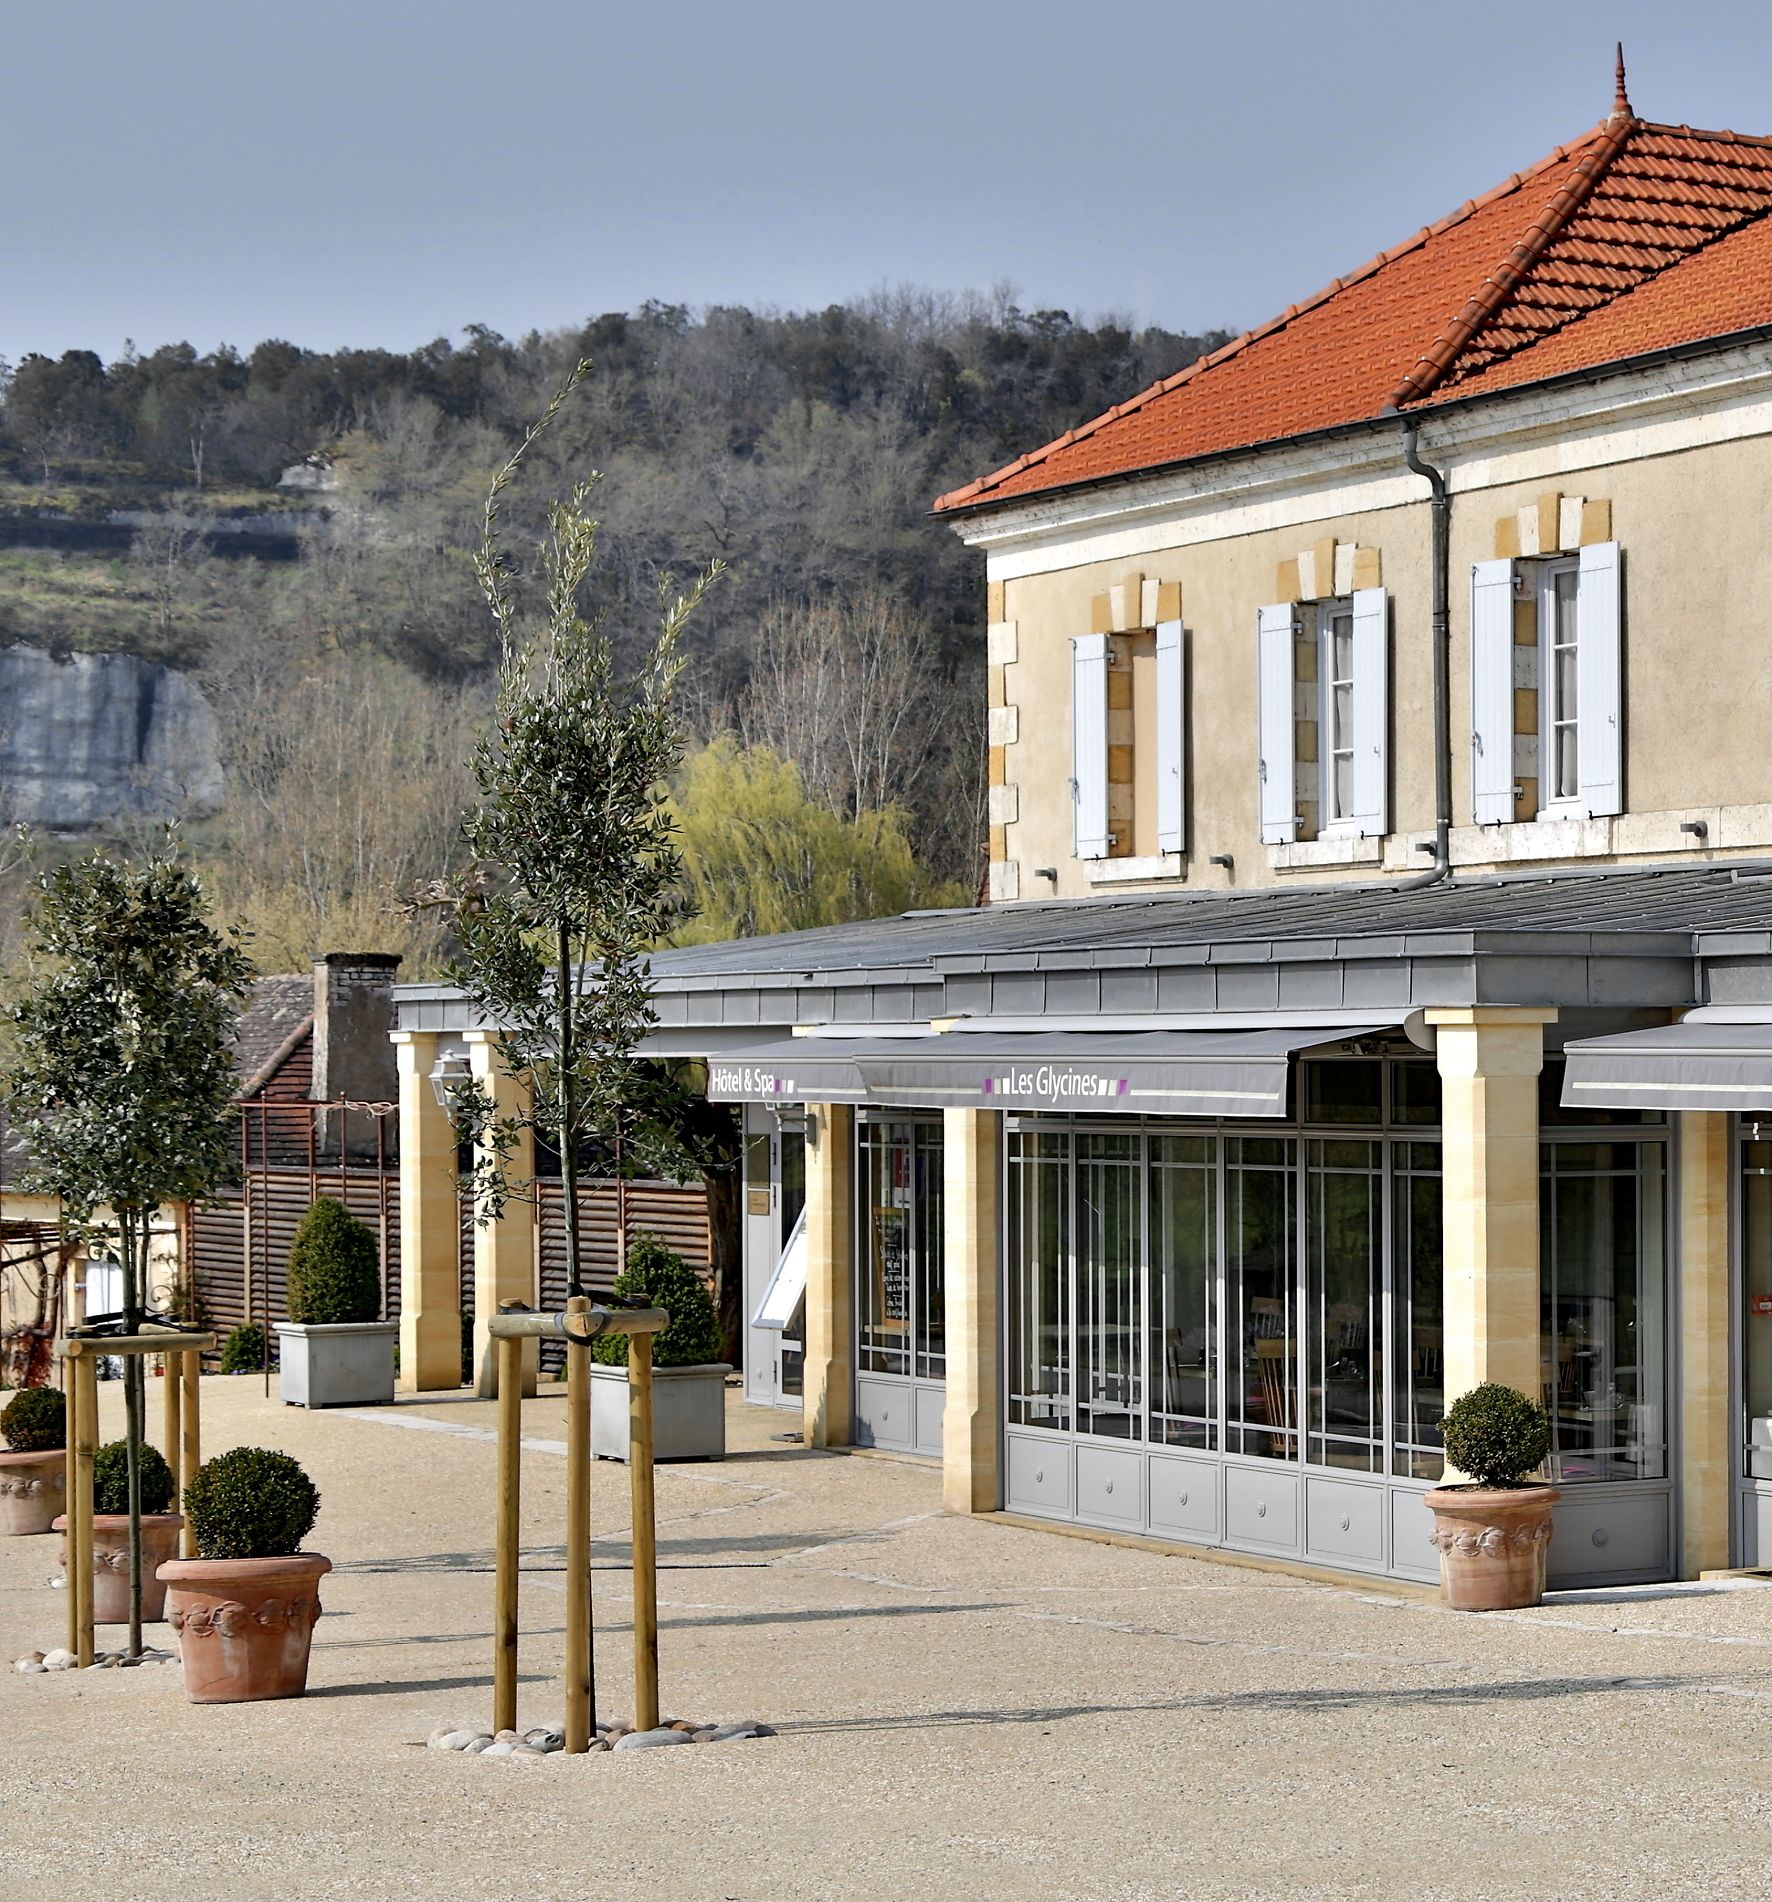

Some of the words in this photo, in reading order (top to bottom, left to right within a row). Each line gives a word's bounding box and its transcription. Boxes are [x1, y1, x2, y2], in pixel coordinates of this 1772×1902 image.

[712, 1067, 742, 1093] Hôtel
[744, 1068, 752, 1093] &
[754, 1068, 775, 1097] Spa
[1010, 1066, 1033, 1095] Les
[1036, 1065, 1098, 1103] Glycines
